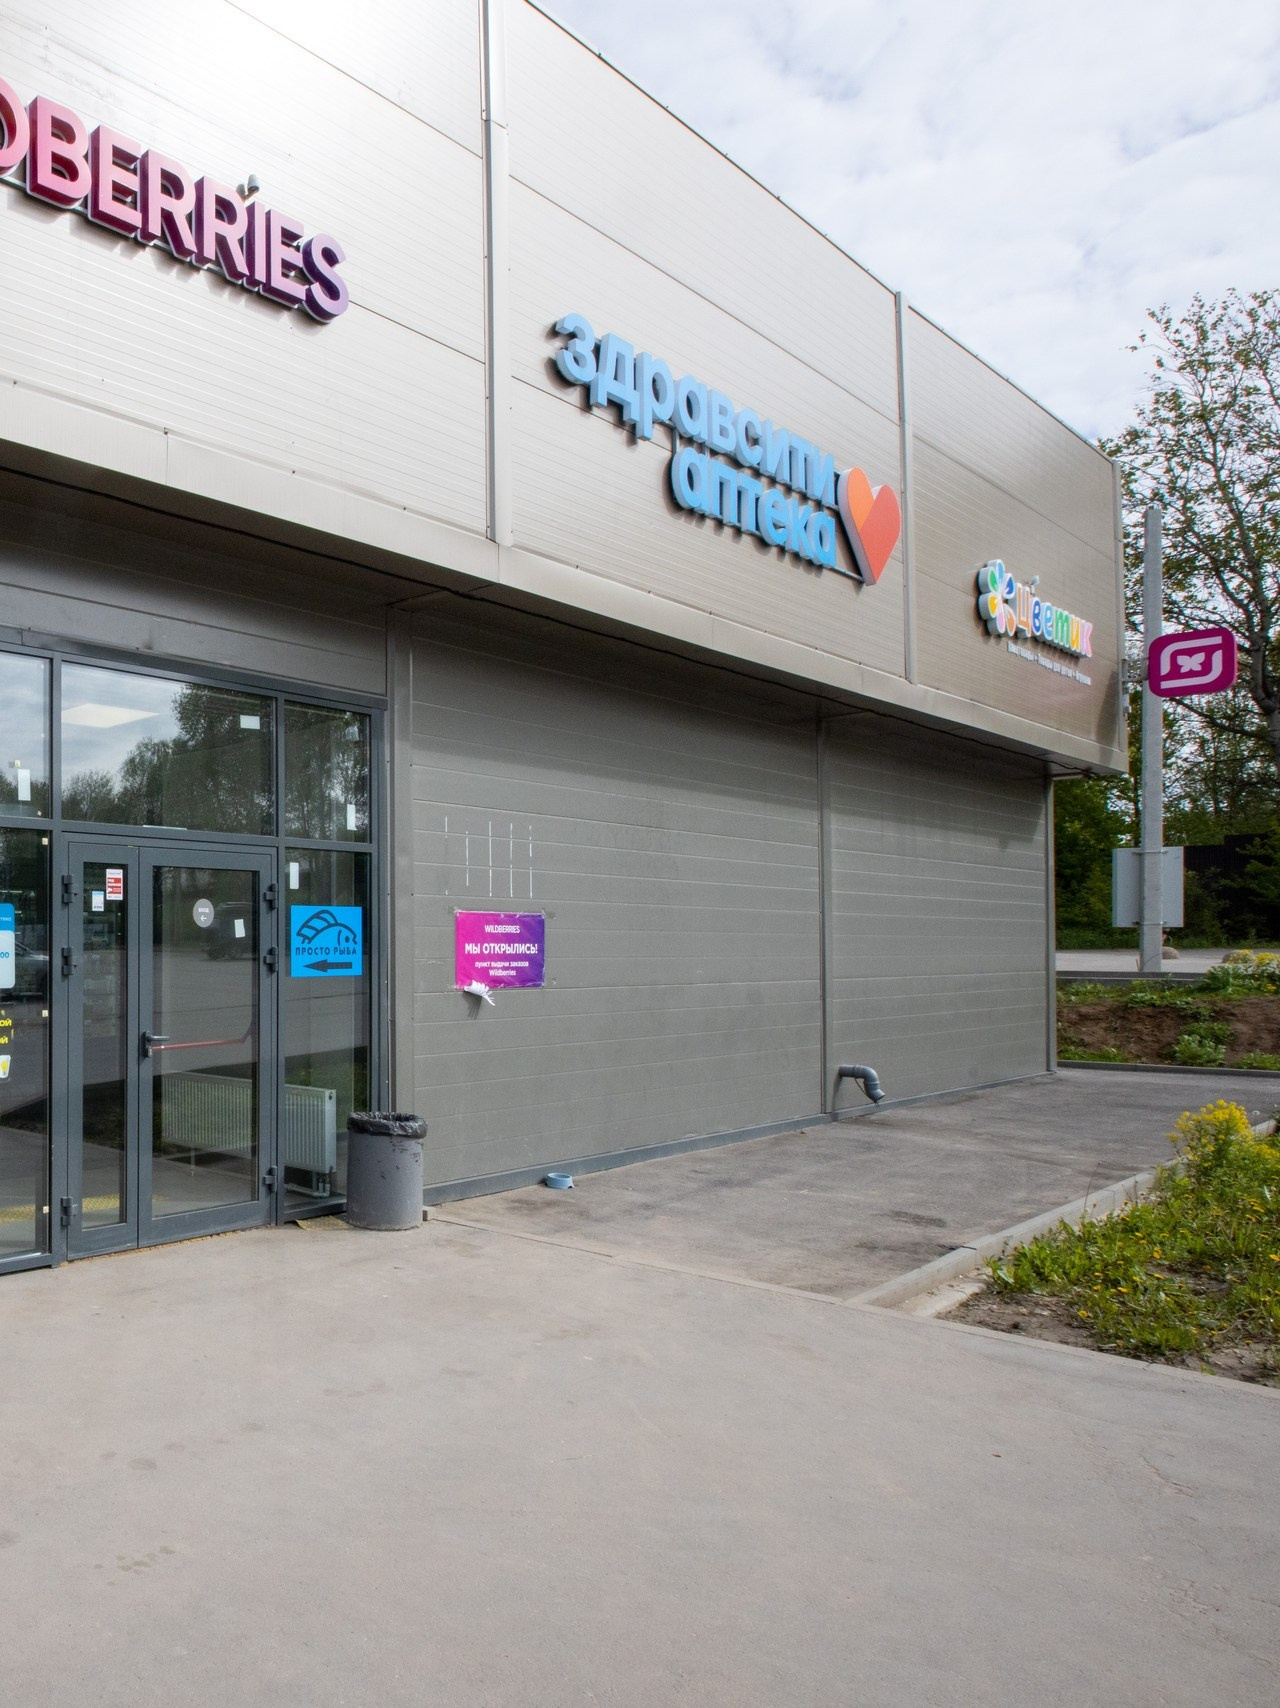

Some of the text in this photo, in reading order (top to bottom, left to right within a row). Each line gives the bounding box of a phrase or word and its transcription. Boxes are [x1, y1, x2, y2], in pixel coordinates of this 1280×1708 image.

[671, 447, 837, 569] аптека
[484, 924, 521, 934] WILDBERRIES
[295, 946, 357, 956] ПРОСТО РЫБА
[464, 943, 538, 954] МЫ ОТКРЫЛИСЬ!
[488, 968, 516, 976] Wildberries
